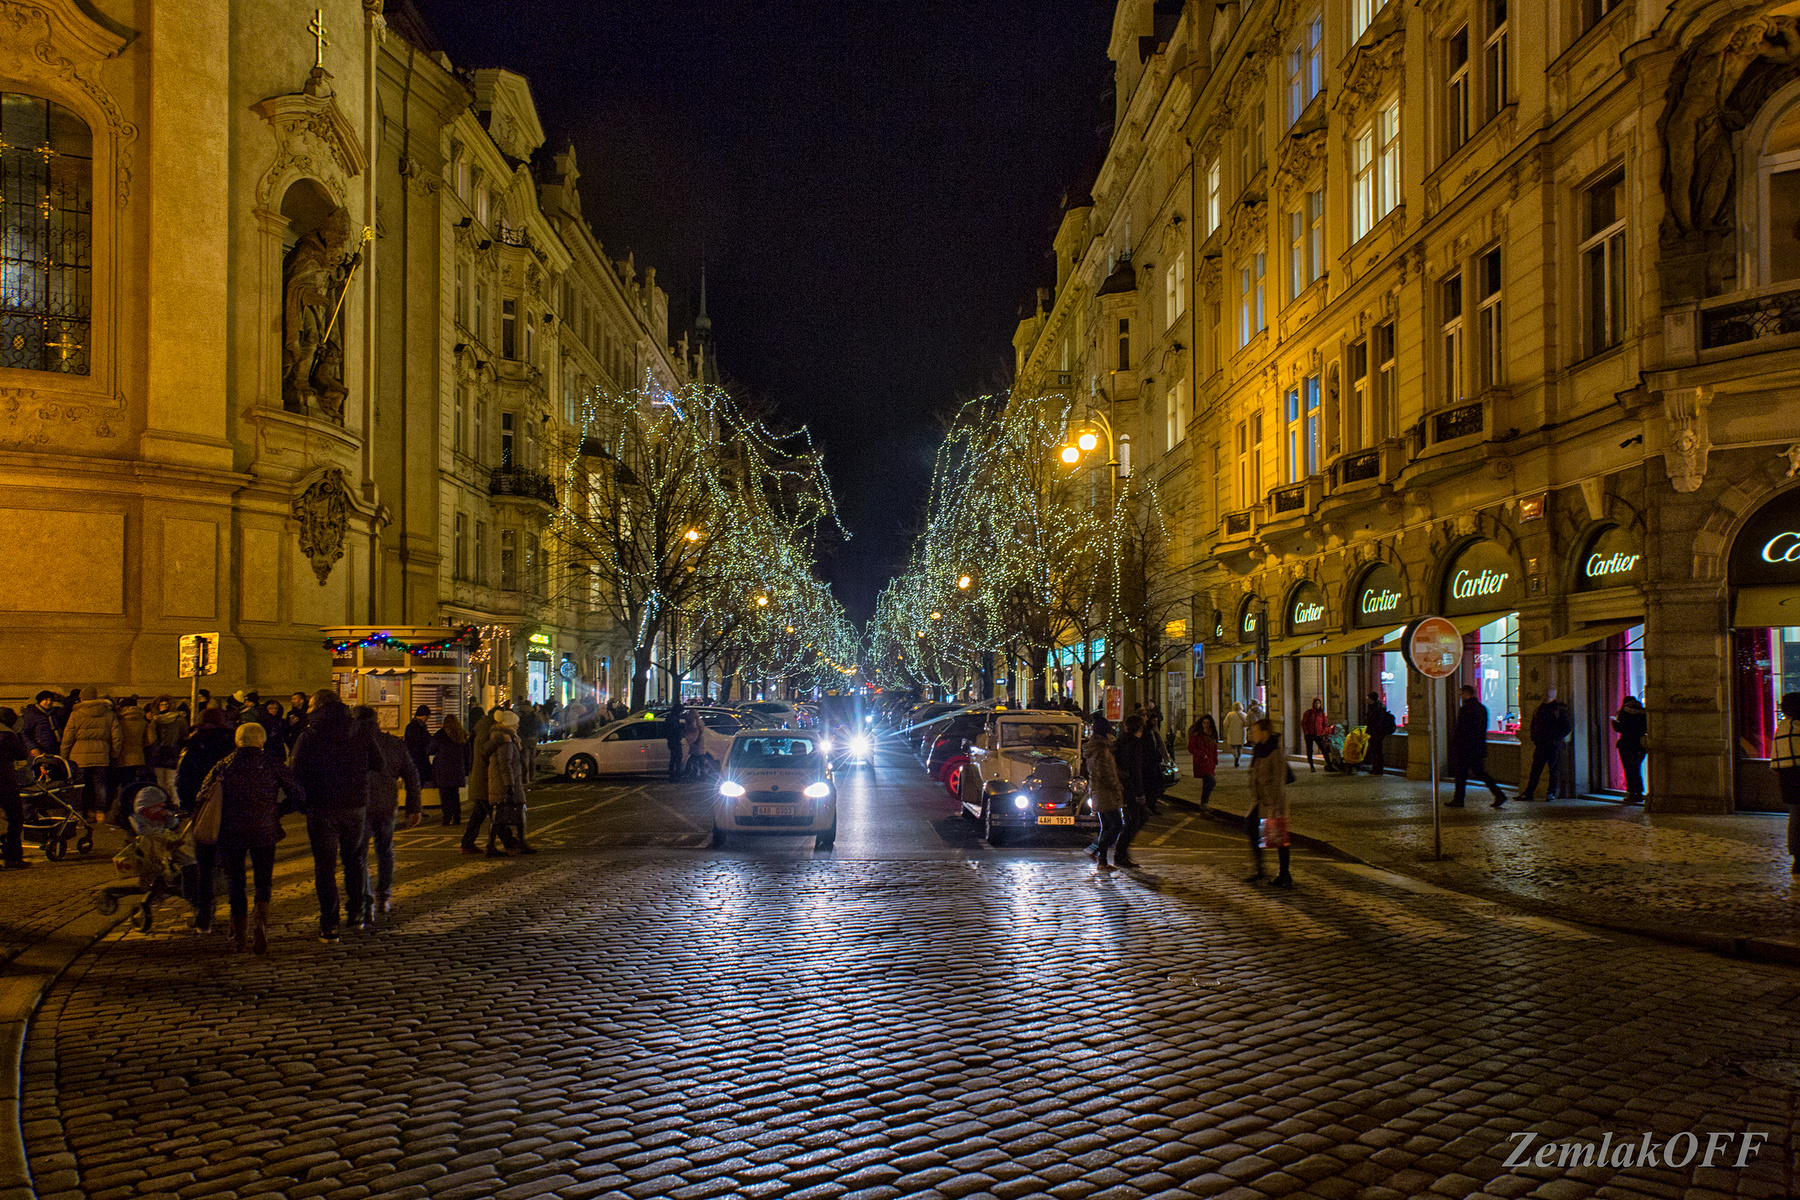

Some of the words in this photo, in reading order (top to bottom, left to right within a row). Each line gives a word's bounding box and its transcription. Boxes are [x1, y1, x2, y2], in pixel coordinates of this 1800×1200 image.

[1585, 552, 1640, 577] Cartier
[1452, 569, 1509, 599] Cartier
[1294, 602, 1325, 624] Cartier
[1362, 588, 1402, 614] Cartier
